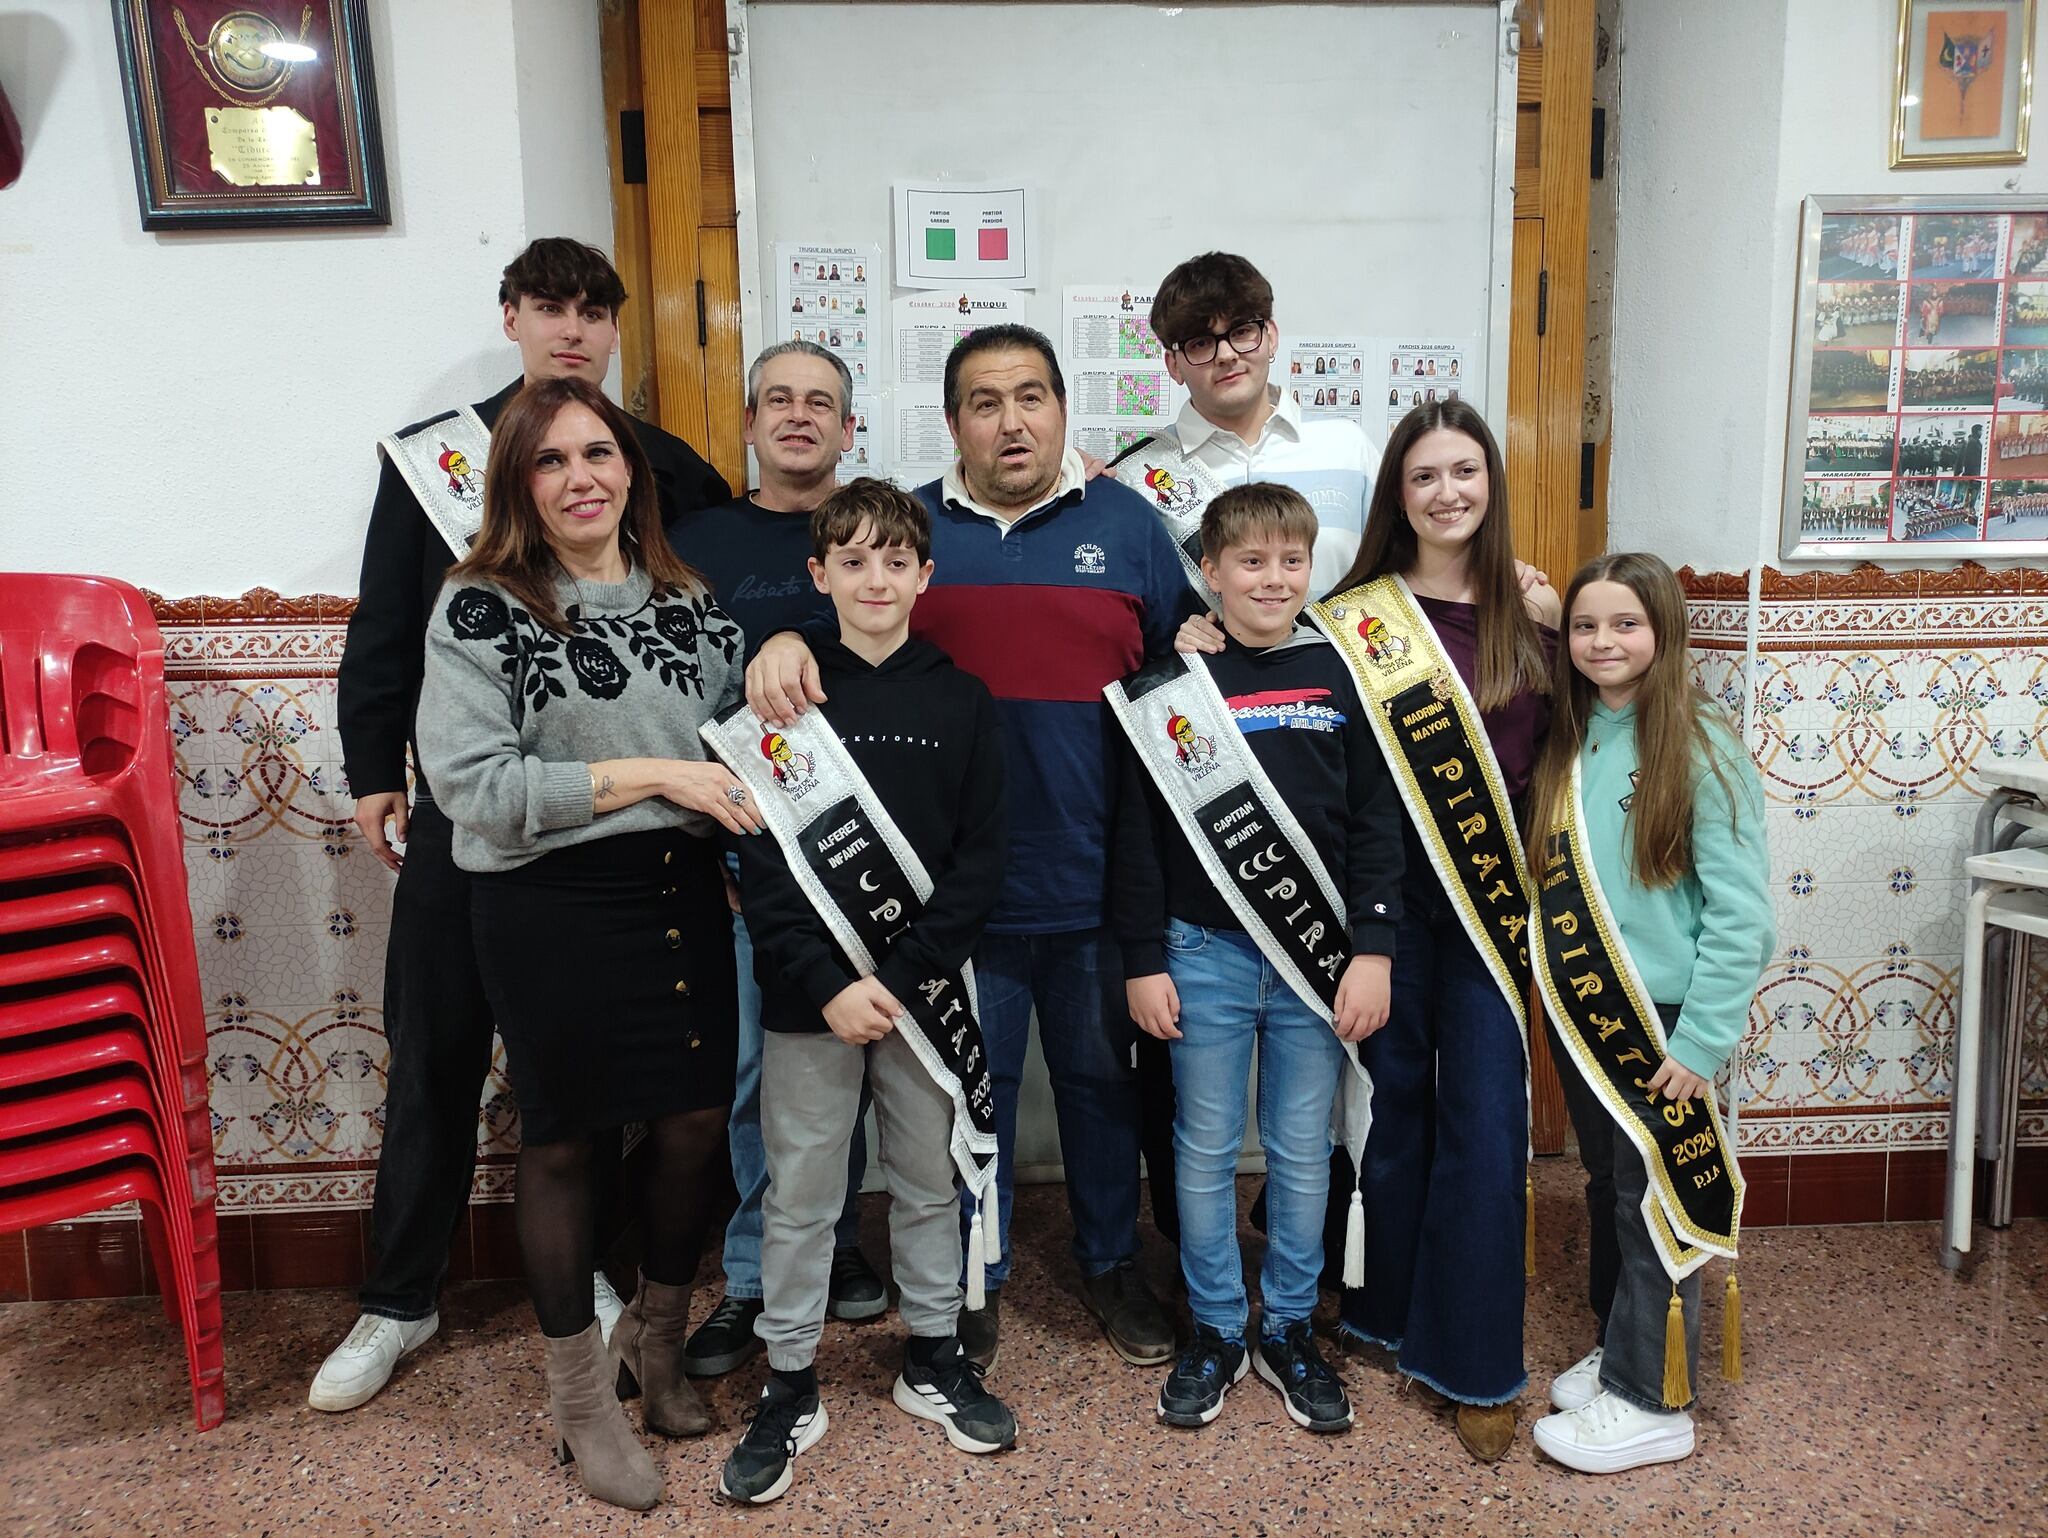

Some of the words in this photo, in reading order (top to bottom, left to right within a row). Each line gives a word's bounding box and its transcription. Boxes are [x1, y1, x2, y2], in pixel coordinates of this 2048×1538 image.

[971, 301, 1008, 309] TRUQUE
[1382, 658, 1414, 677] VILLENA
[1402, 700, 1446, 728] MADRINA
[1411, 716, 1452, 743] MAYOR
[1192, 762, 1221, 782] VILLENA
[791, 779, 821, 802] VILLENA
[1212, 801, 1256, 834] CAPITAN
[816, 818, 860, 854] ALFEREZ
[1223, 821, 1263, 851] INFANTIL
[827, 836, 870, 869] INFANTIL
[1672, 1125, 1717, 1167] 2026
